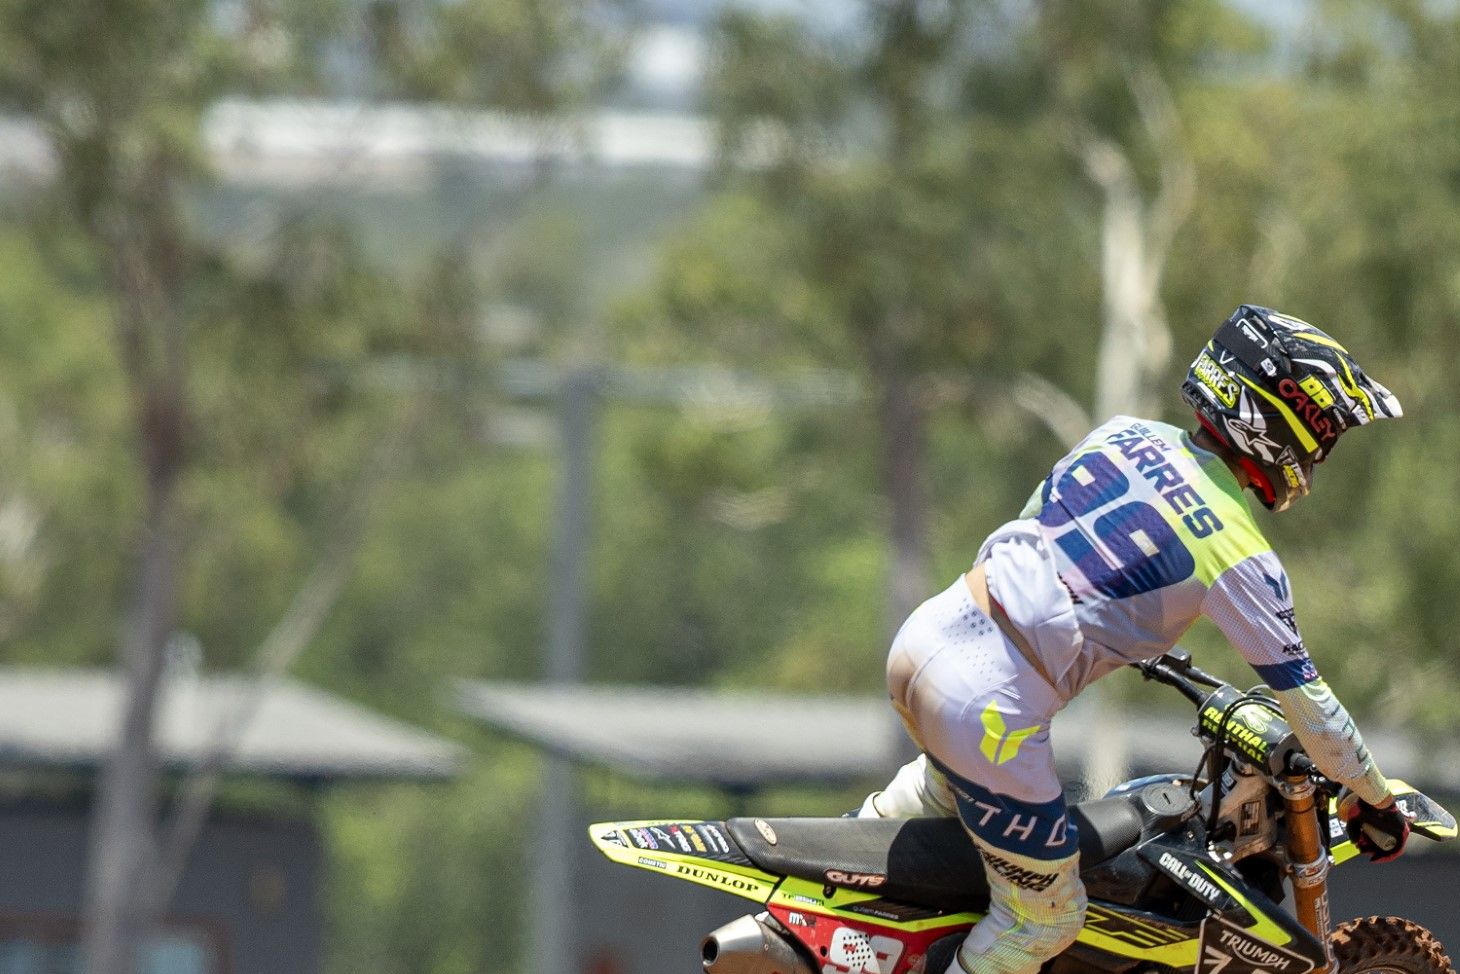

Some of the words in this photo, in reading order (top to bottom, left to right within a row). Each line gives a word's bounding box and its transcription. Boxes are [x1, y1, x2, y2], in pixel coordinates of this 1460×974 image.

[1279, 378, 1336, 441] OAKLEY
[1104, 429, 1224, 539] FARRES
[1037, 451, 1195, 599] 99
[676, 865, 759, 892] DUNLOP
[826, 870, 886, 887] GUTS
[1159, 852, 1188, 880] CALL
[1187, 872, 1221, 901] DUTY
[1221, 930, 1291, 971] TRIUMPH
